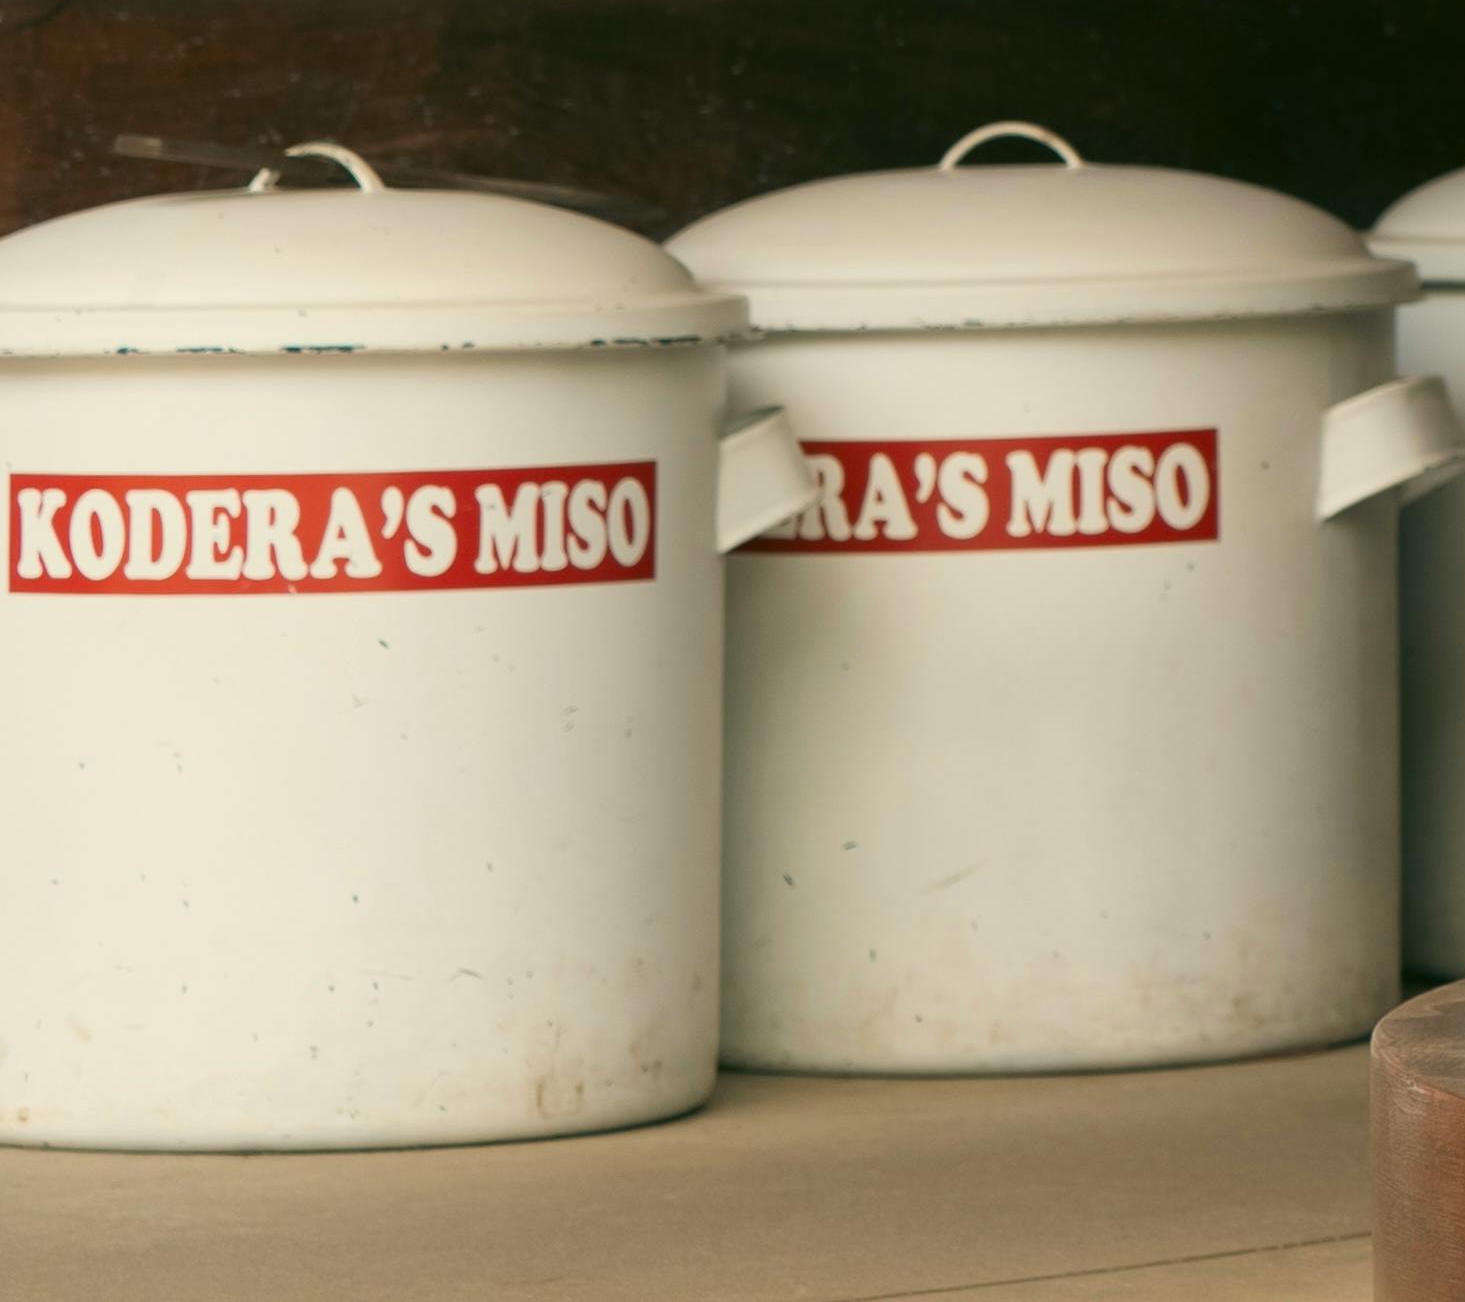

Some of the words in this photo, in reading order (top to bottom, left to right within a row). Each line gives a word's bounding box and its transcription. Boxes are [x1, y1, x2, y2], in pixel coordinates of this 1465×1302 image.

[17, 483, 458, 583] KODERA'S
[475, 474, 651, 576] MISO
[1005, 442, 1211, 537] MISO
